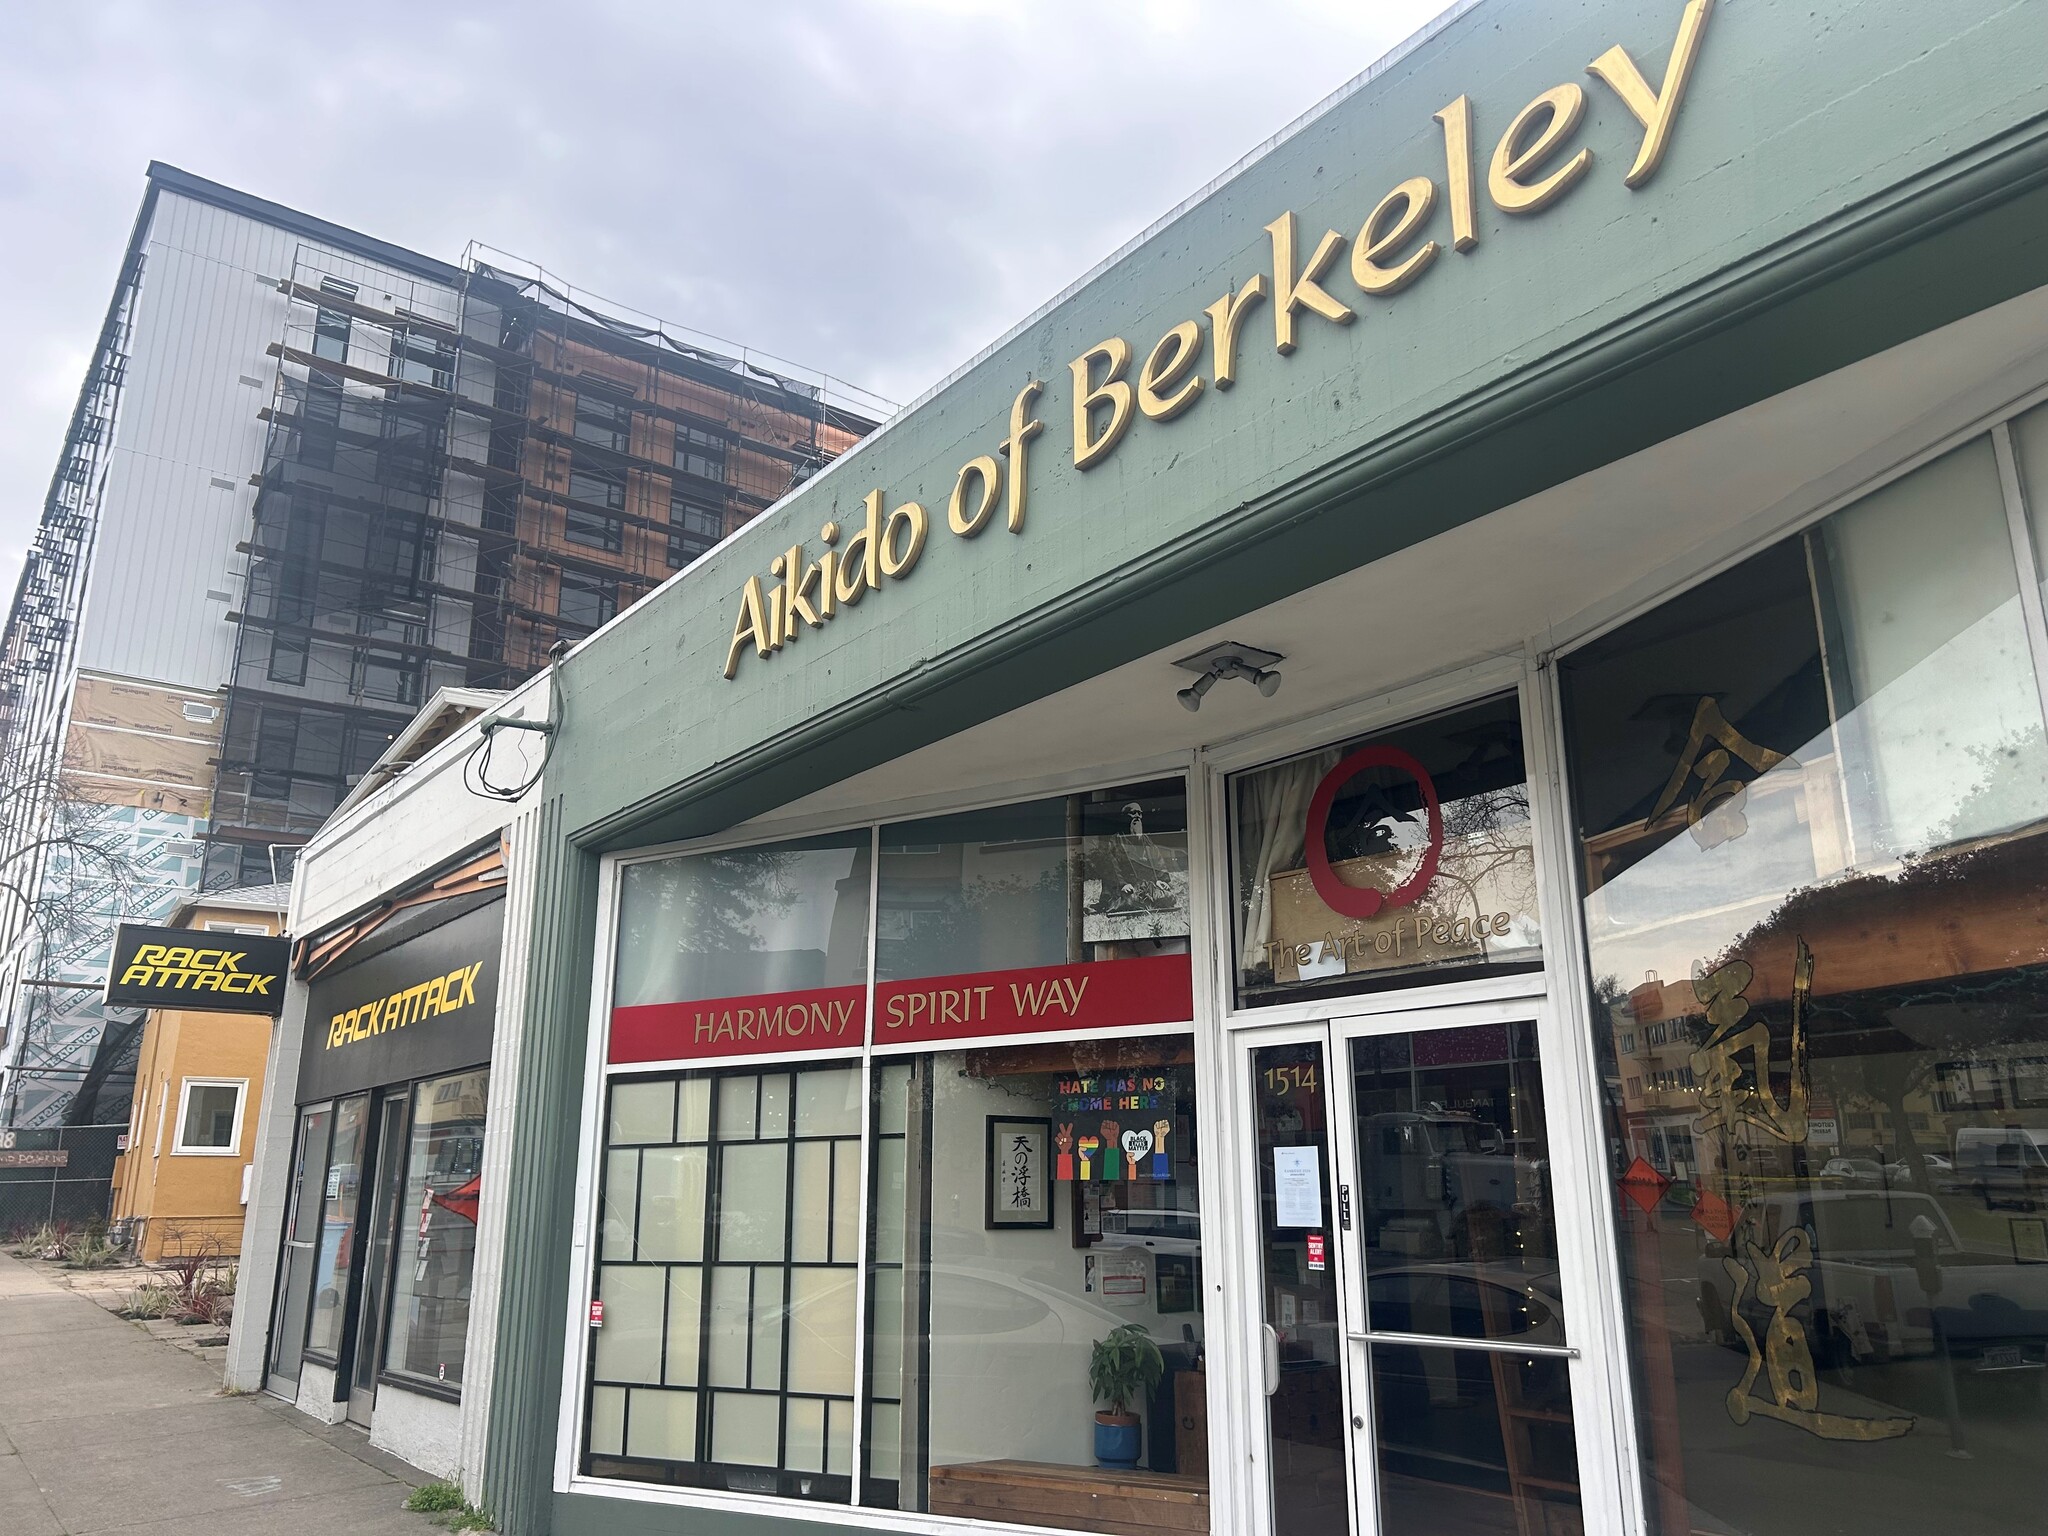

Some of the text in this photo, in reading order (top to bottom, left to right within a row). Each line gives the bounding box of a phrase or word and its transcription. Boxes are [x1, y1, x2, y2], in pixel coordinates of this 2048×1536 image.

[724, 0, 1713, 680] Aikido of Berkeley
[131, 944, 248, 972] RACK
[1263, 911, 1511, 971] The Art of Peace
[119, 964, 277, 996] ATTACK
[326, 960, 483, 1050] RACK ATTACK
[693, 976, 1090, 1046] HARMONY SPIRIT WAY
[1059, 1076, 1166, 1094] HATE HAS NO
[1264, 1064, 1318, 1096] 1514
[1067, 1095, 1159, 1111] HOME HERE
[1011, 1135, 1033, 1208] 天の浮橋
[1341, 1185, 1349, 1220] PULL
